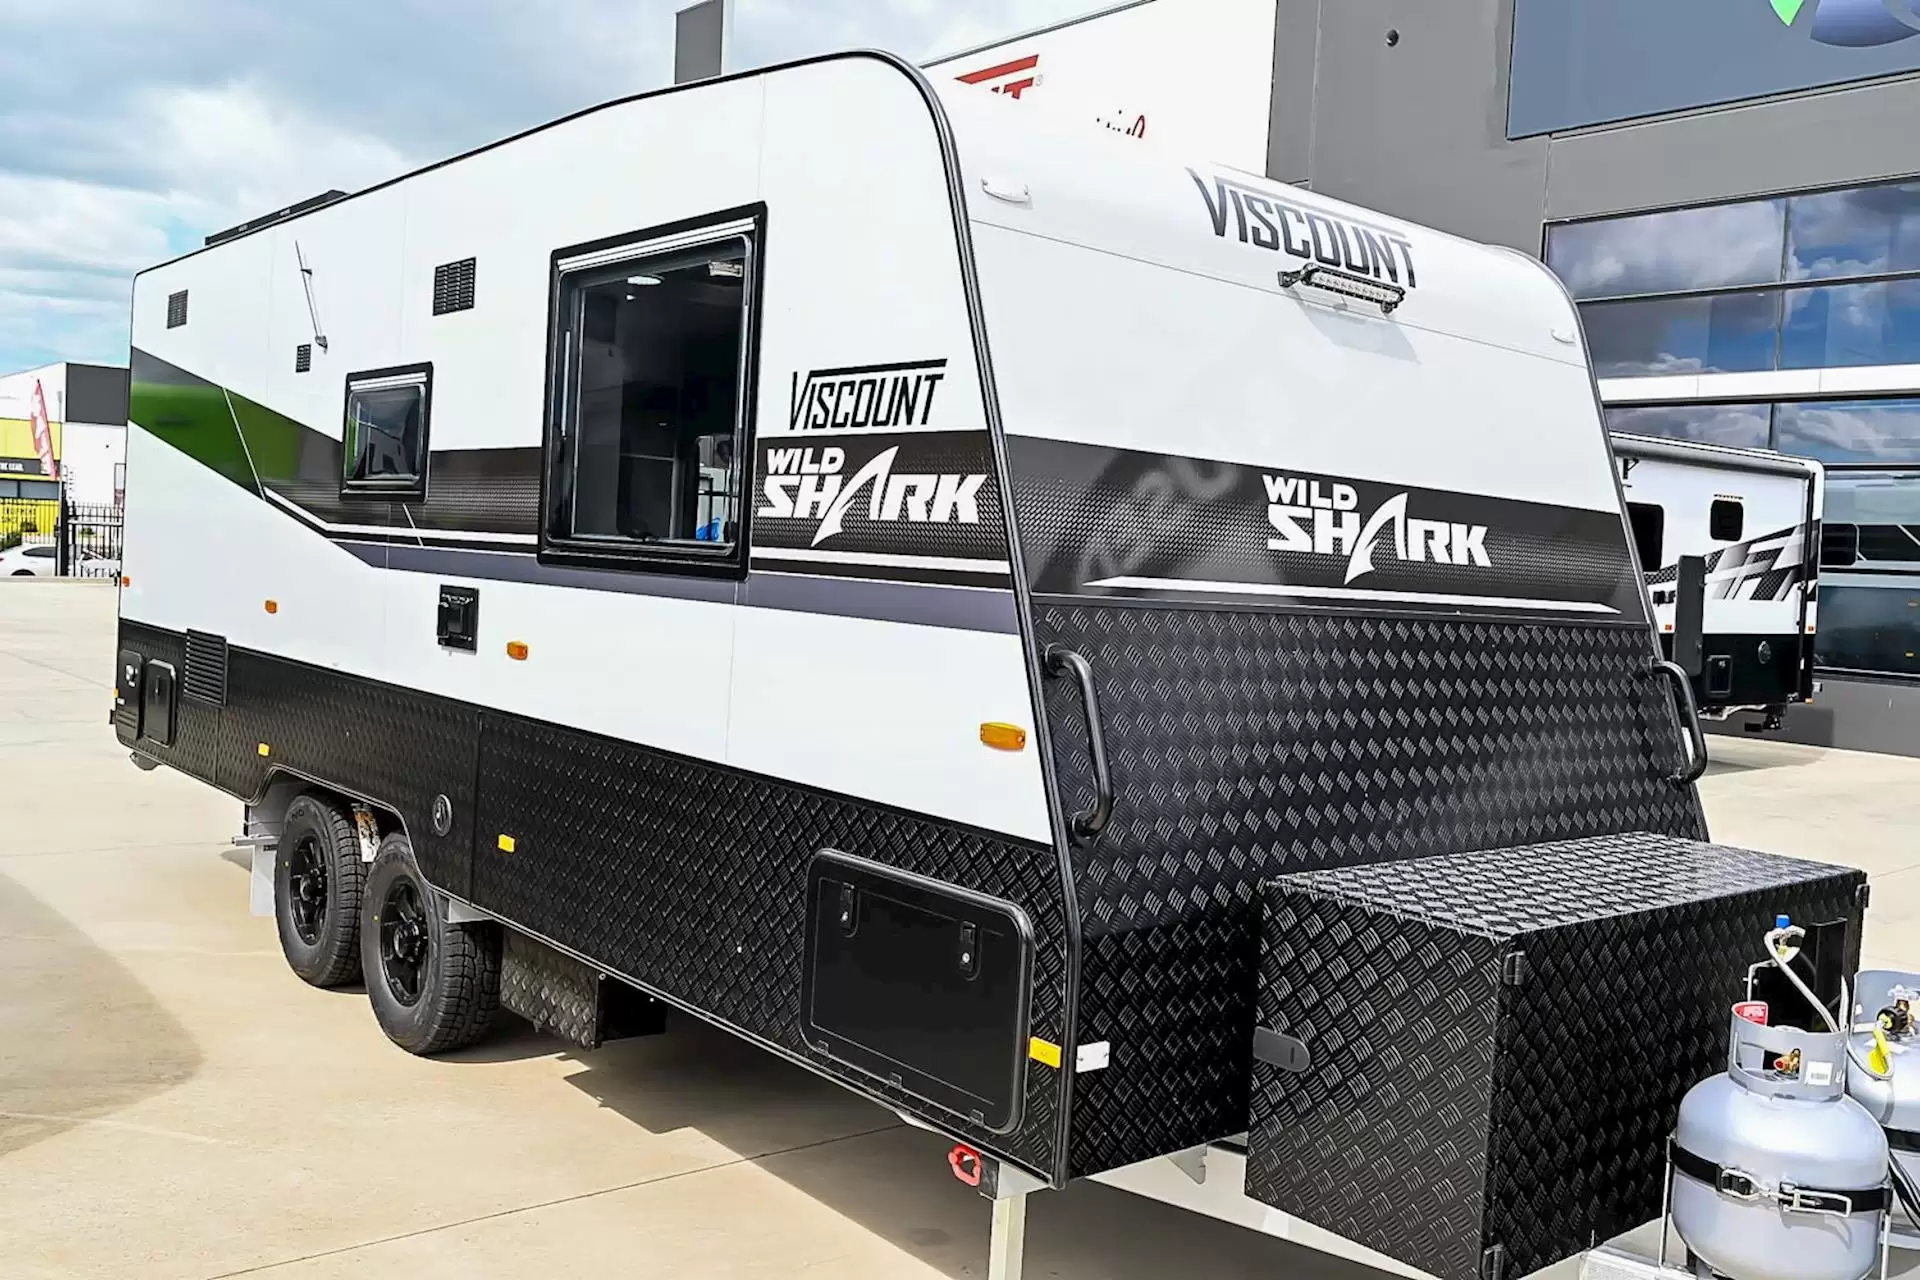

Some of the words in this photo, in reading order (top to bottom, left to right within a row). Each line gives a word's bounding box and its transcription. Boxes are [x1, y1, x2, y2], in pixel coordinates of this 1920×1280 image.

[1184, 166, 1416, 289] VISCOUNT
[789, 358, 947, 430] VISCOUNT
[756, 445, 988, 547] SHARK
[766, 447, 845, 475] WILD
[1262, 474, 1358, 511] WILD
[1267, 492, 1492, 585] SHARK
